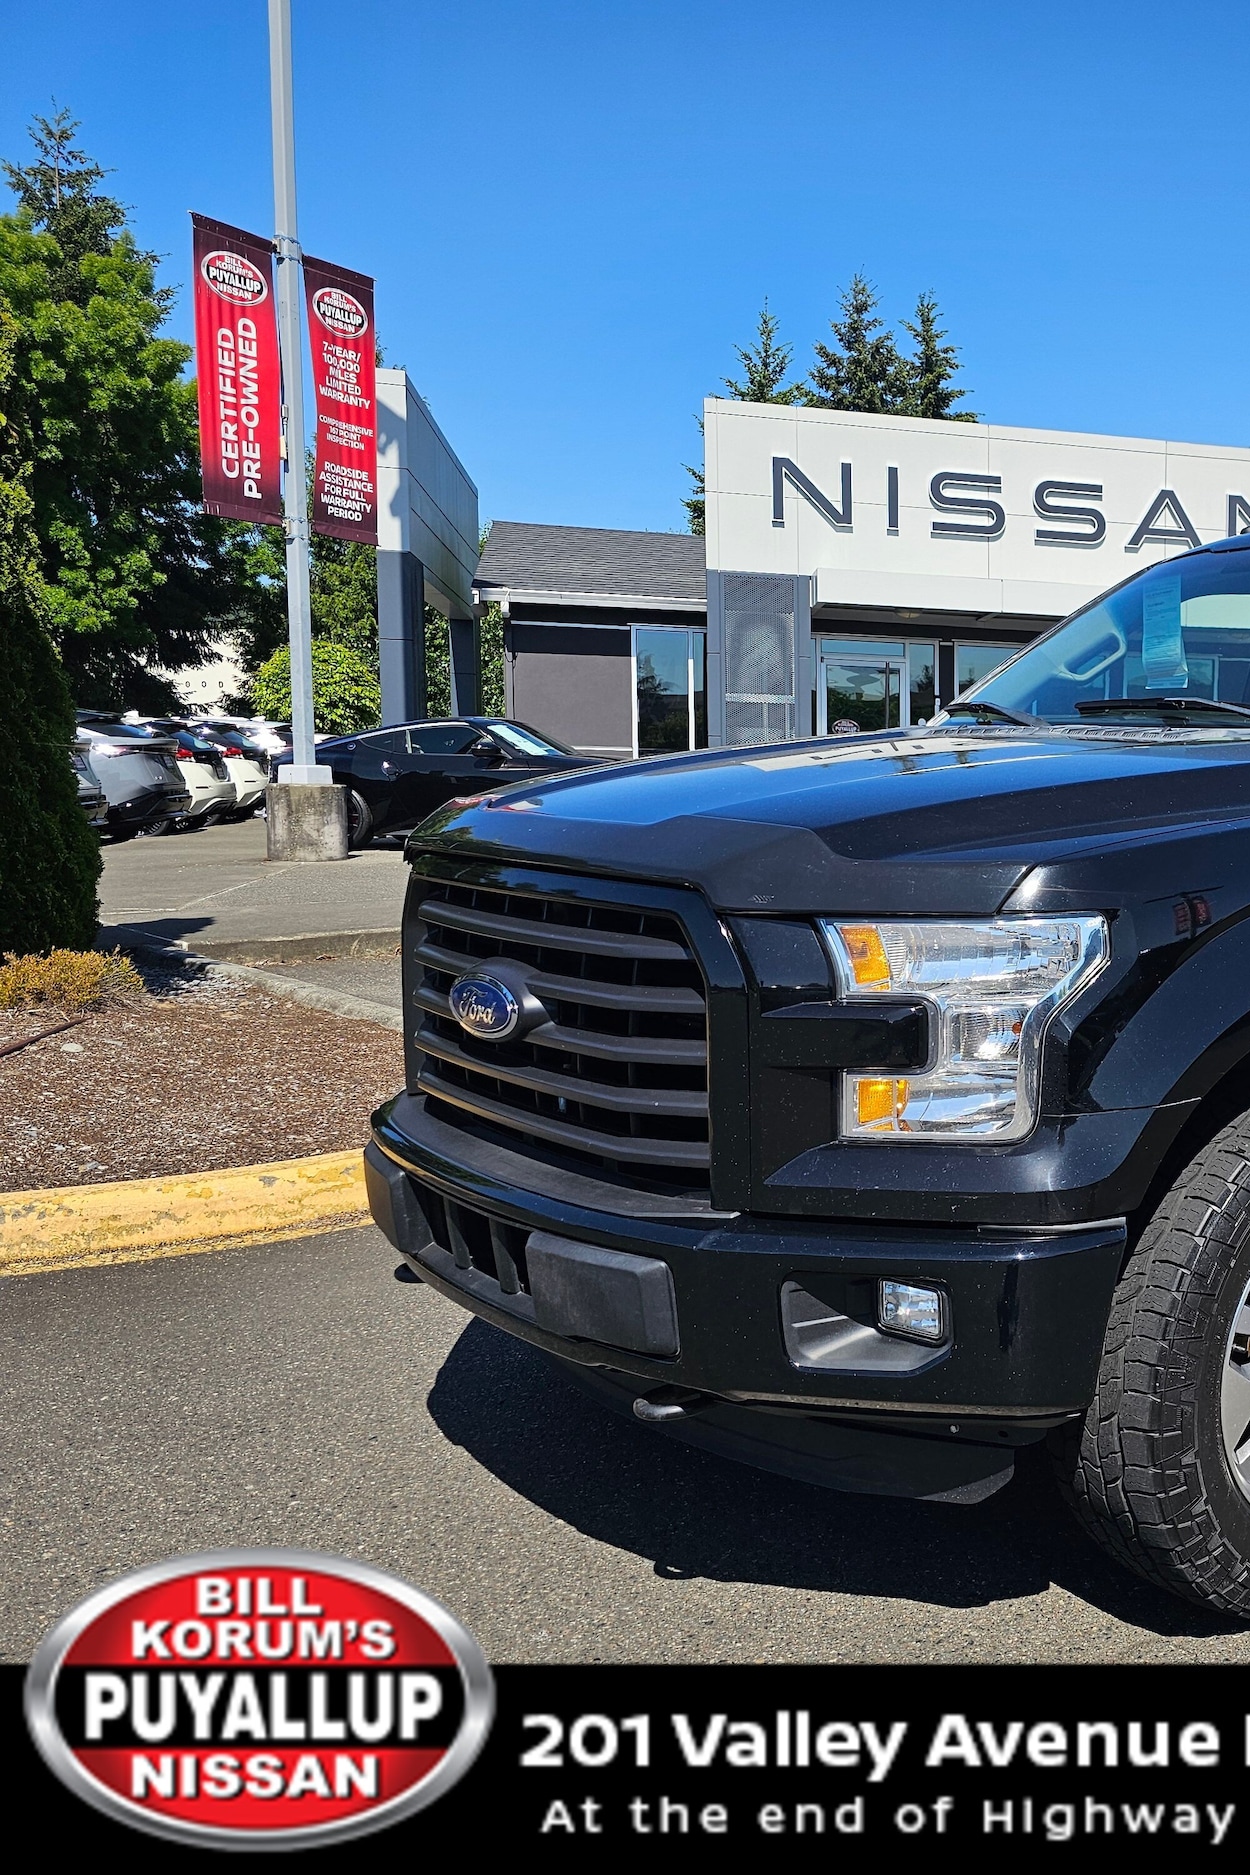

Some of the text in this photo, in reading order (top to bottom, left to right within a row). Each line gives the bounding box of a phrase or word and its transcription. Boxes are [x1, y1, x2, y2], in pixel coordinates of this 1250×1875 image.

[216, 259, 254, 278] KORUM'S
[224, 255, 243, 268] BILL
[209, 266, 261, 293] PUYALLUP
[216, 281, 252, 300] NISSAN
[331, 292, 347, 303] BILL
[320, 302, 363, 326] PUYALLUP
[323, 296, 357, 312] KORUM'S
[325, 316, 355, 333] NISSAN
[322, 353, 361, 373] 100,000
[329, 366, 357, 383] MILES
[325, 375, 361, 396] LIMITED
[217, 328, 240, 479] CERTIFIED
[319, 384, 370, 409] WARRANTY
[238, 317, 262, 499] PRE-OWNED
[319, 414, 373, 437] COMPREHENSIVE
[338, 430, 361, 441] POINT
[326, 433, 365, 450] INSPECTION
[324, 461, 369, 481] ROADSIDE
[319, 471, 374, 493] ASSISTANCE
[320, 492, 372, 513] WARRANTY
[324, 483, 366, 502] FOR FULL
[327, 505, 362, 521] PERIOD
[459, 986, 497, 1025] Ford
